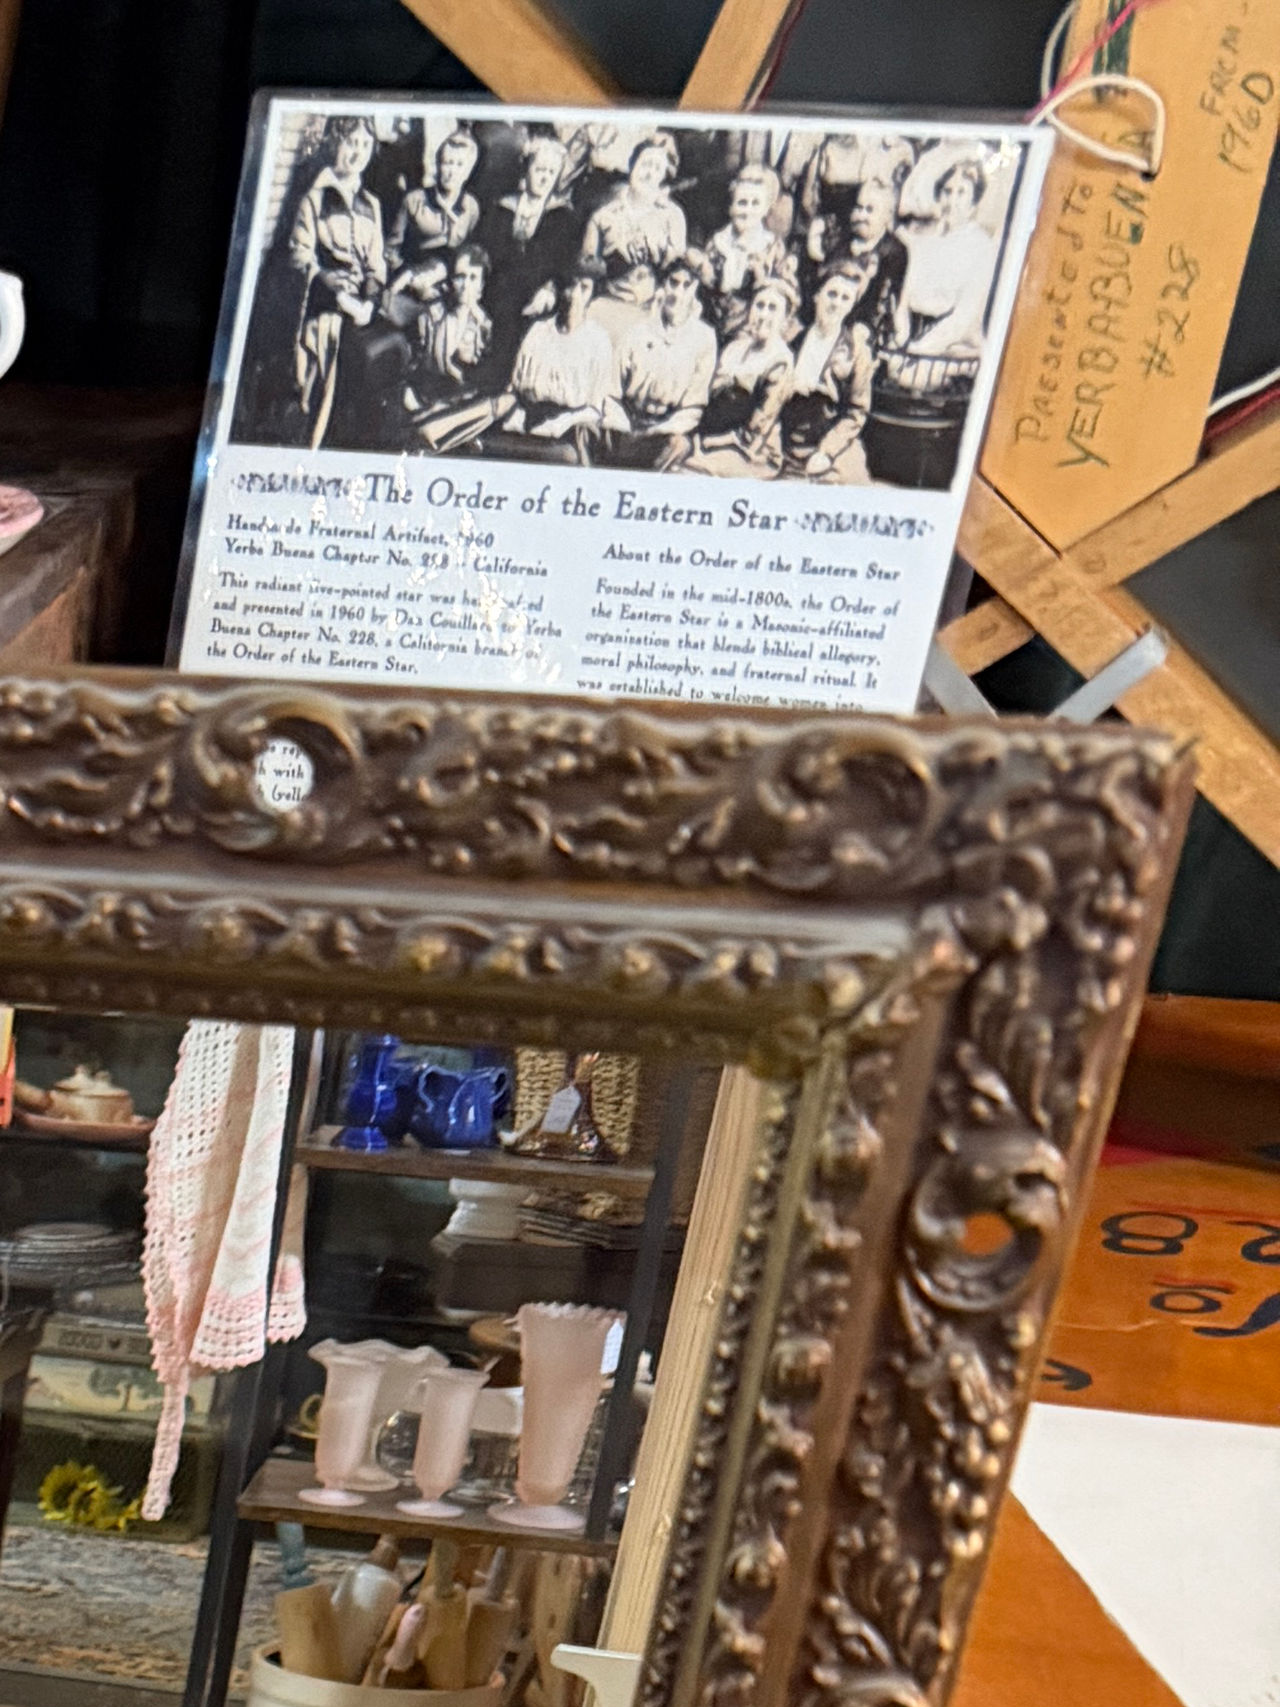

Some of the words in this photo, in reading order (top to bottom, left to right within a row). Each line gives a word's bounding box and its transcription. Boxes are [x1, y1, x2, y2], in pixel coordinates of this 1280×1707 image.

[1141, 243, 1202, 382] #228
[362, 472, 415, 504] The
[426, 477, 509, 511] Order
[520, 484, 552, 514] of
[561, 488, 601, 519] the
[613, 489, 713, 527] Eastern
[727, 498, 788, 531] Star
[309, 519, 377, 541] Fraternal
[382, 524, 449, 547] Artifact,
[225, 536, 264, 557] Yerba
[271, 540, 316, 560] Buena
[601, 543, 651, 563] About
[658, 546, 683, 565] the
[689, 548, 739, 569] Order
[744, 552, 763, 571] of
[768, 554, 793, 573] the
[799, 556, 859, 579] Eastern
[865, 561, 902, 581] Star
[218, 570, 249, 589] This
[255, 574, 303, 593] radiant
[213, 595, 238, 612] and
[243, 599, 305, 617] presented
[310, 602, 324, 618] in
[329, 604, 366, 621] 1960
[371, 606, 389, 625] by
[595, 576, 656, 599] Founded
[661, 581, 676, 600] in
[682, 583, 705, 602] the
[800, 593, 824, 611] the
[830, 595, 877, 615] Order
[882, 599, 903, 617] of
[590, 600, 613, 619] the
[619, 602, 673, 623] Eastern
[678, 607, 712, 627] Star
[717, 610, 730, 628] is
[209, 616, 252, 635] Buena
[257, 621, 312, 643] Chapter
[207, 640, 227, 658] the
[232, 642, 276, 662] Order
[280, 646, 297, 665] of
[301, 647, 323, 666] the
[328, 650, 379, 670] Eastern
[677, 631, 706, 651] that
[711, 634, 757, 654] blends
[761, 638, 815, 660] biblical
[580, 650, 622, 668] moral
[626, 653, 705, 677] philosophy,
[710, 660, 738, 678] and
[743, 661, 808, 684] fraternal
[864, 671, 878, 690] It
[576, 679, 603, 690] was
[608, 677, 684, 698] established
[690, 687, 704, 700] to
[272, 762, 304, 779] with
